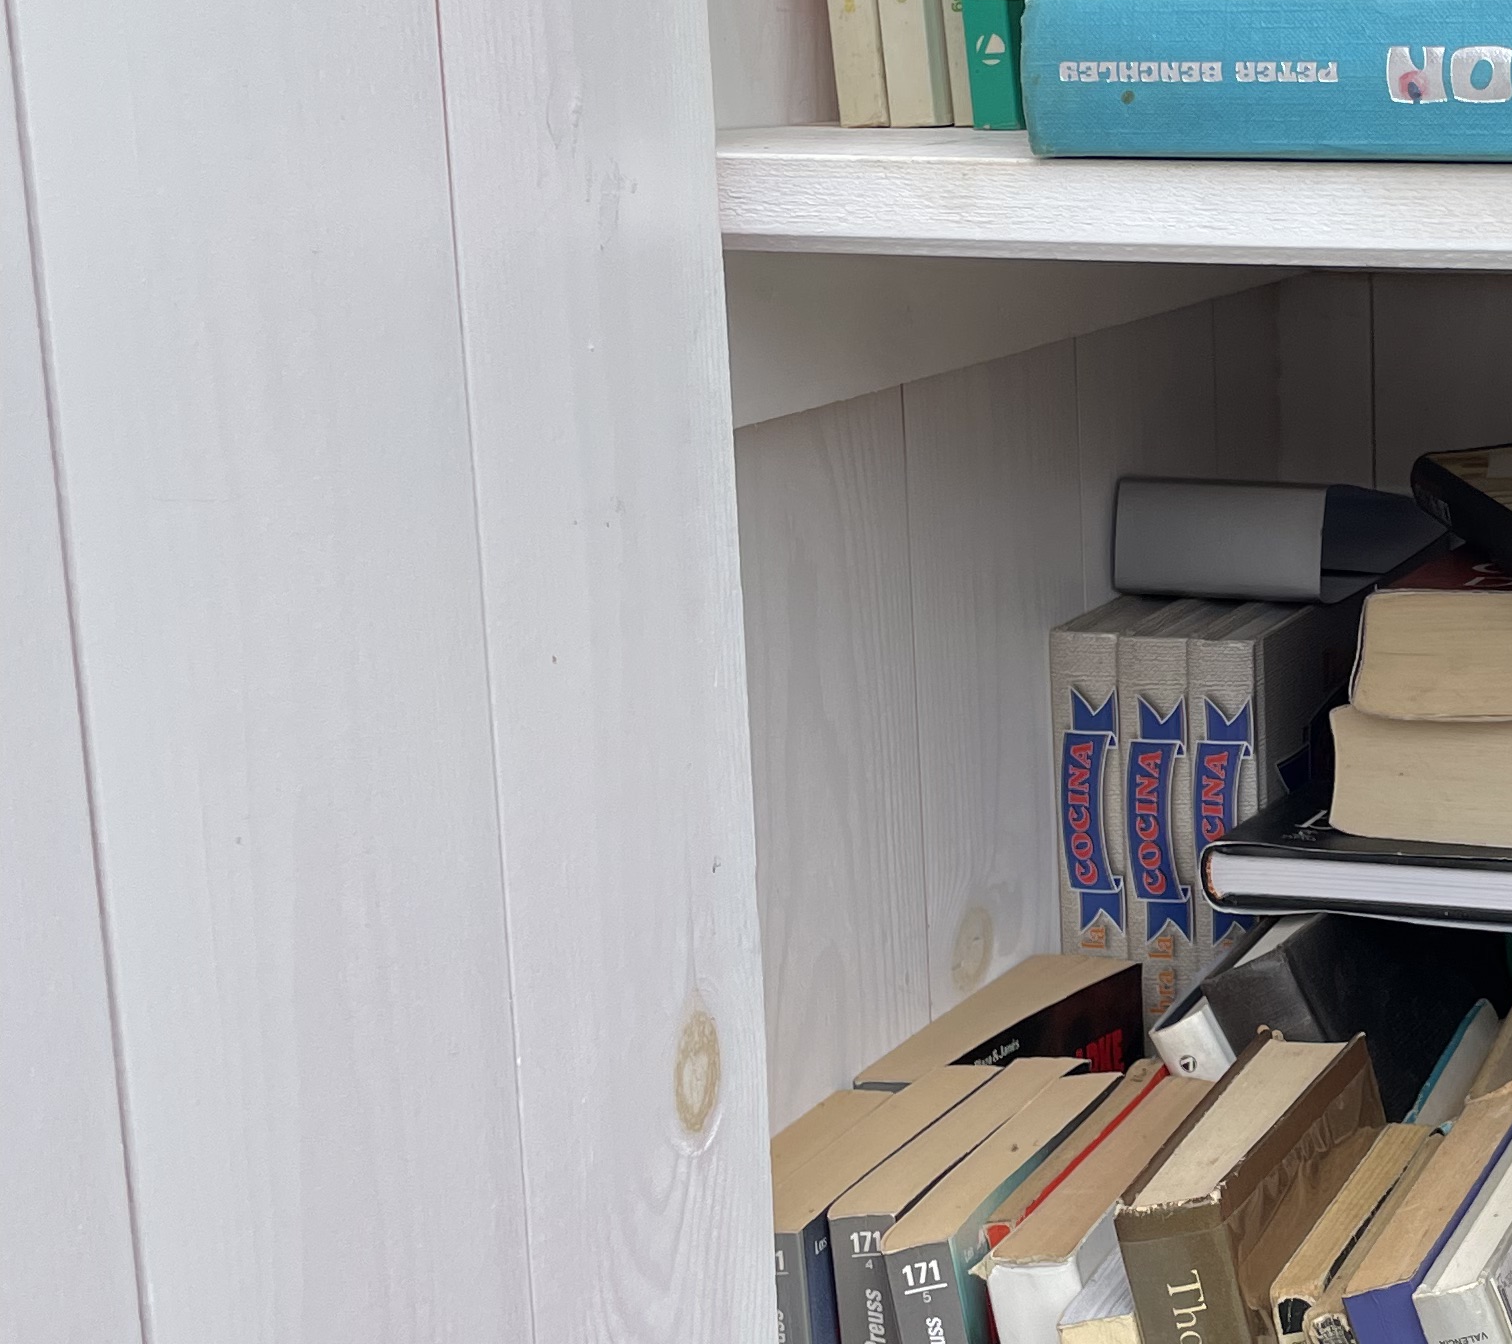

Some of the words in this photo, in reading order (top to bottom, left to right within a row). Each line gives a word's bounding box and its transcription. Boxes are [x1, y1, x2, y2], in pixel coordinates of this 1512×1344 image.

[1059, 60, 1224, 84] BENCHLEY
[1235, 60, 1340, 85] PETER
[1067, 740, 1102, 887] COCINA
[902, 1259, 940, 1286] 171
